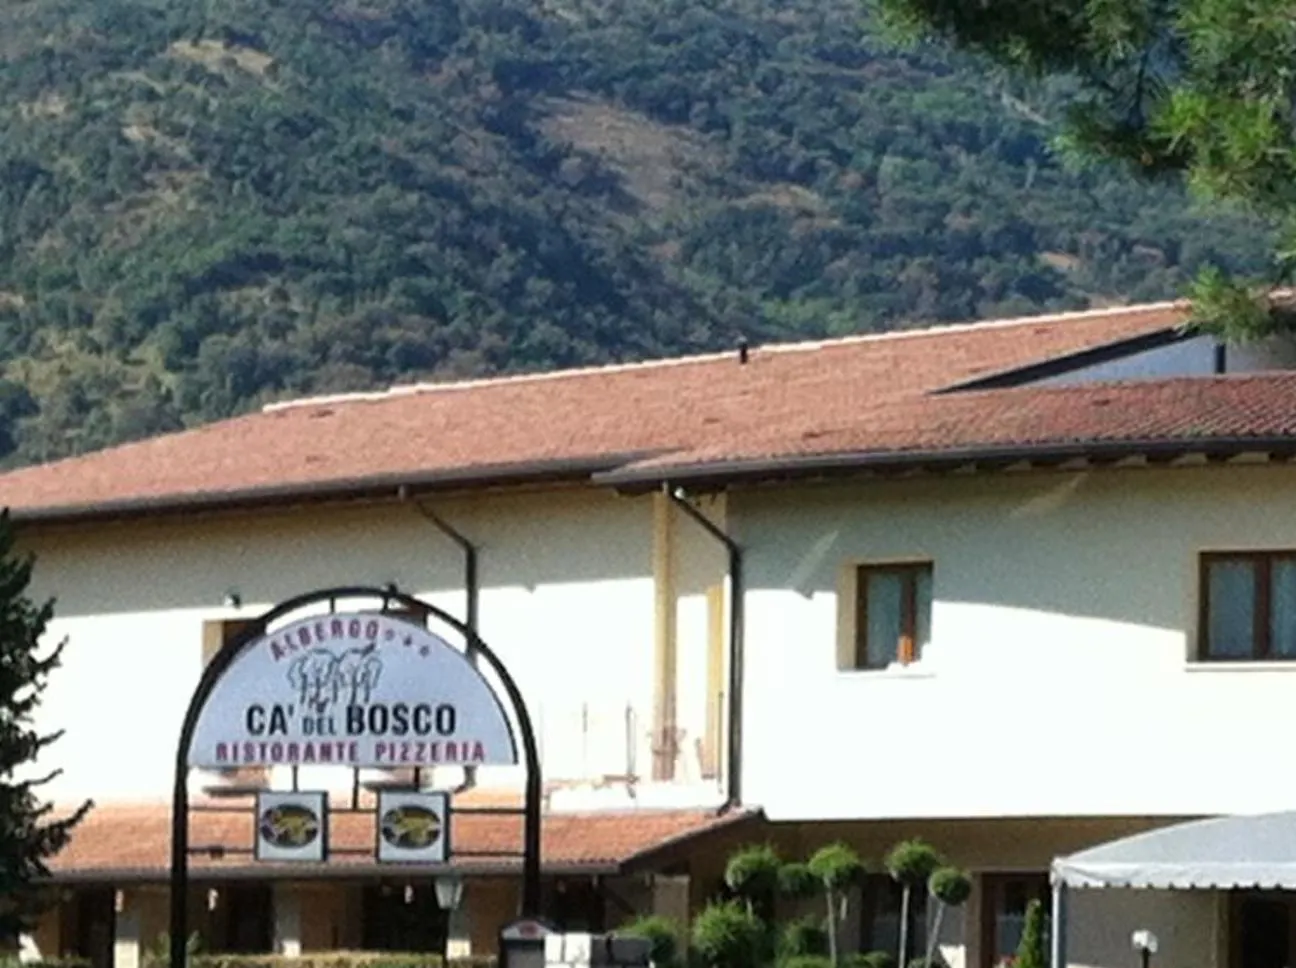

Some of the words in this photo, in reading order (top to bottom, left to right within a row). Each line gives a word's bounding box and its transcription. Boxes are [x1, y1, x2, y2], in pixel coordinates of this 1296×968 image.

[270, 618, 379, 662] ALBERGO
[246, 704, 294, 736] CA'
[303, 716, 336, 736] DEL
[346, 703, 456, 736] BOSCO
[216, 742, 359, 762] RISTORANTE
[375, 741, 485, 762] PIZZERIA
